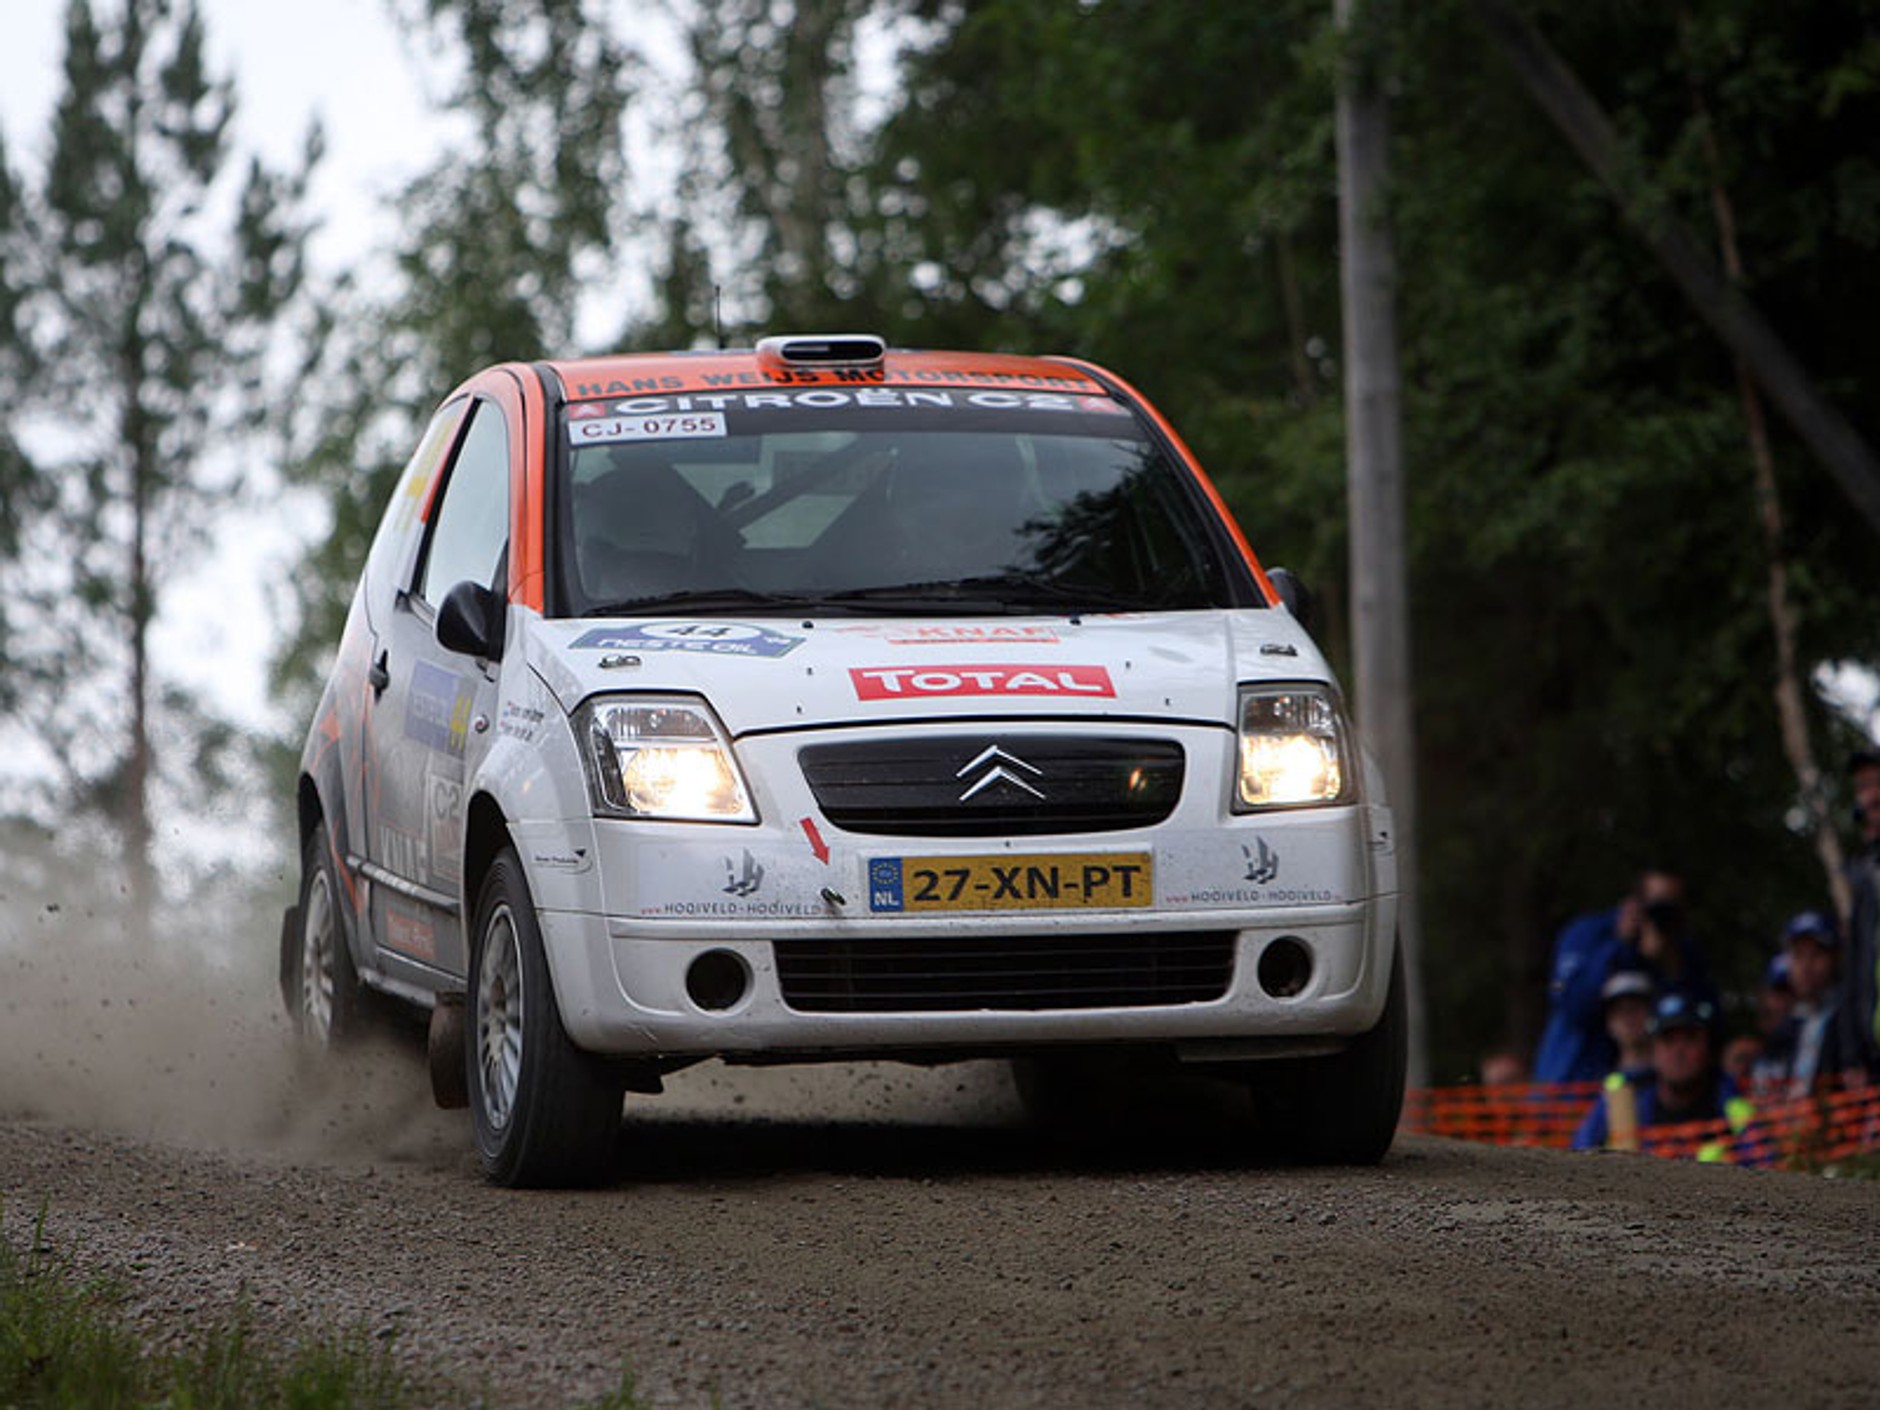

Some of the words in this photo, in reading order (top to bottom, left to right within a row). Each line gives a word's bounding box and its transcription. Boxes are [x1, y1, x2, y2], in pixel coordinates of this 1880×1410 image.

[576, 375, 684, 397] HANS
[701, 368, 820, 386] WEIJS
[833, 368, 1091, 391] MOTORSPORT
[615, 387, 954, 414] CITROËN
[967, 392, 1074, 410] C2
[581, 416, 717, 438] CJ-0755
[666, 625, 731, 637] 44
[862, 669, 1104, 693] TOTAL
[912, 865, 1142, 902] 27-XN-PT
[873, 892, 900, 907] NL
